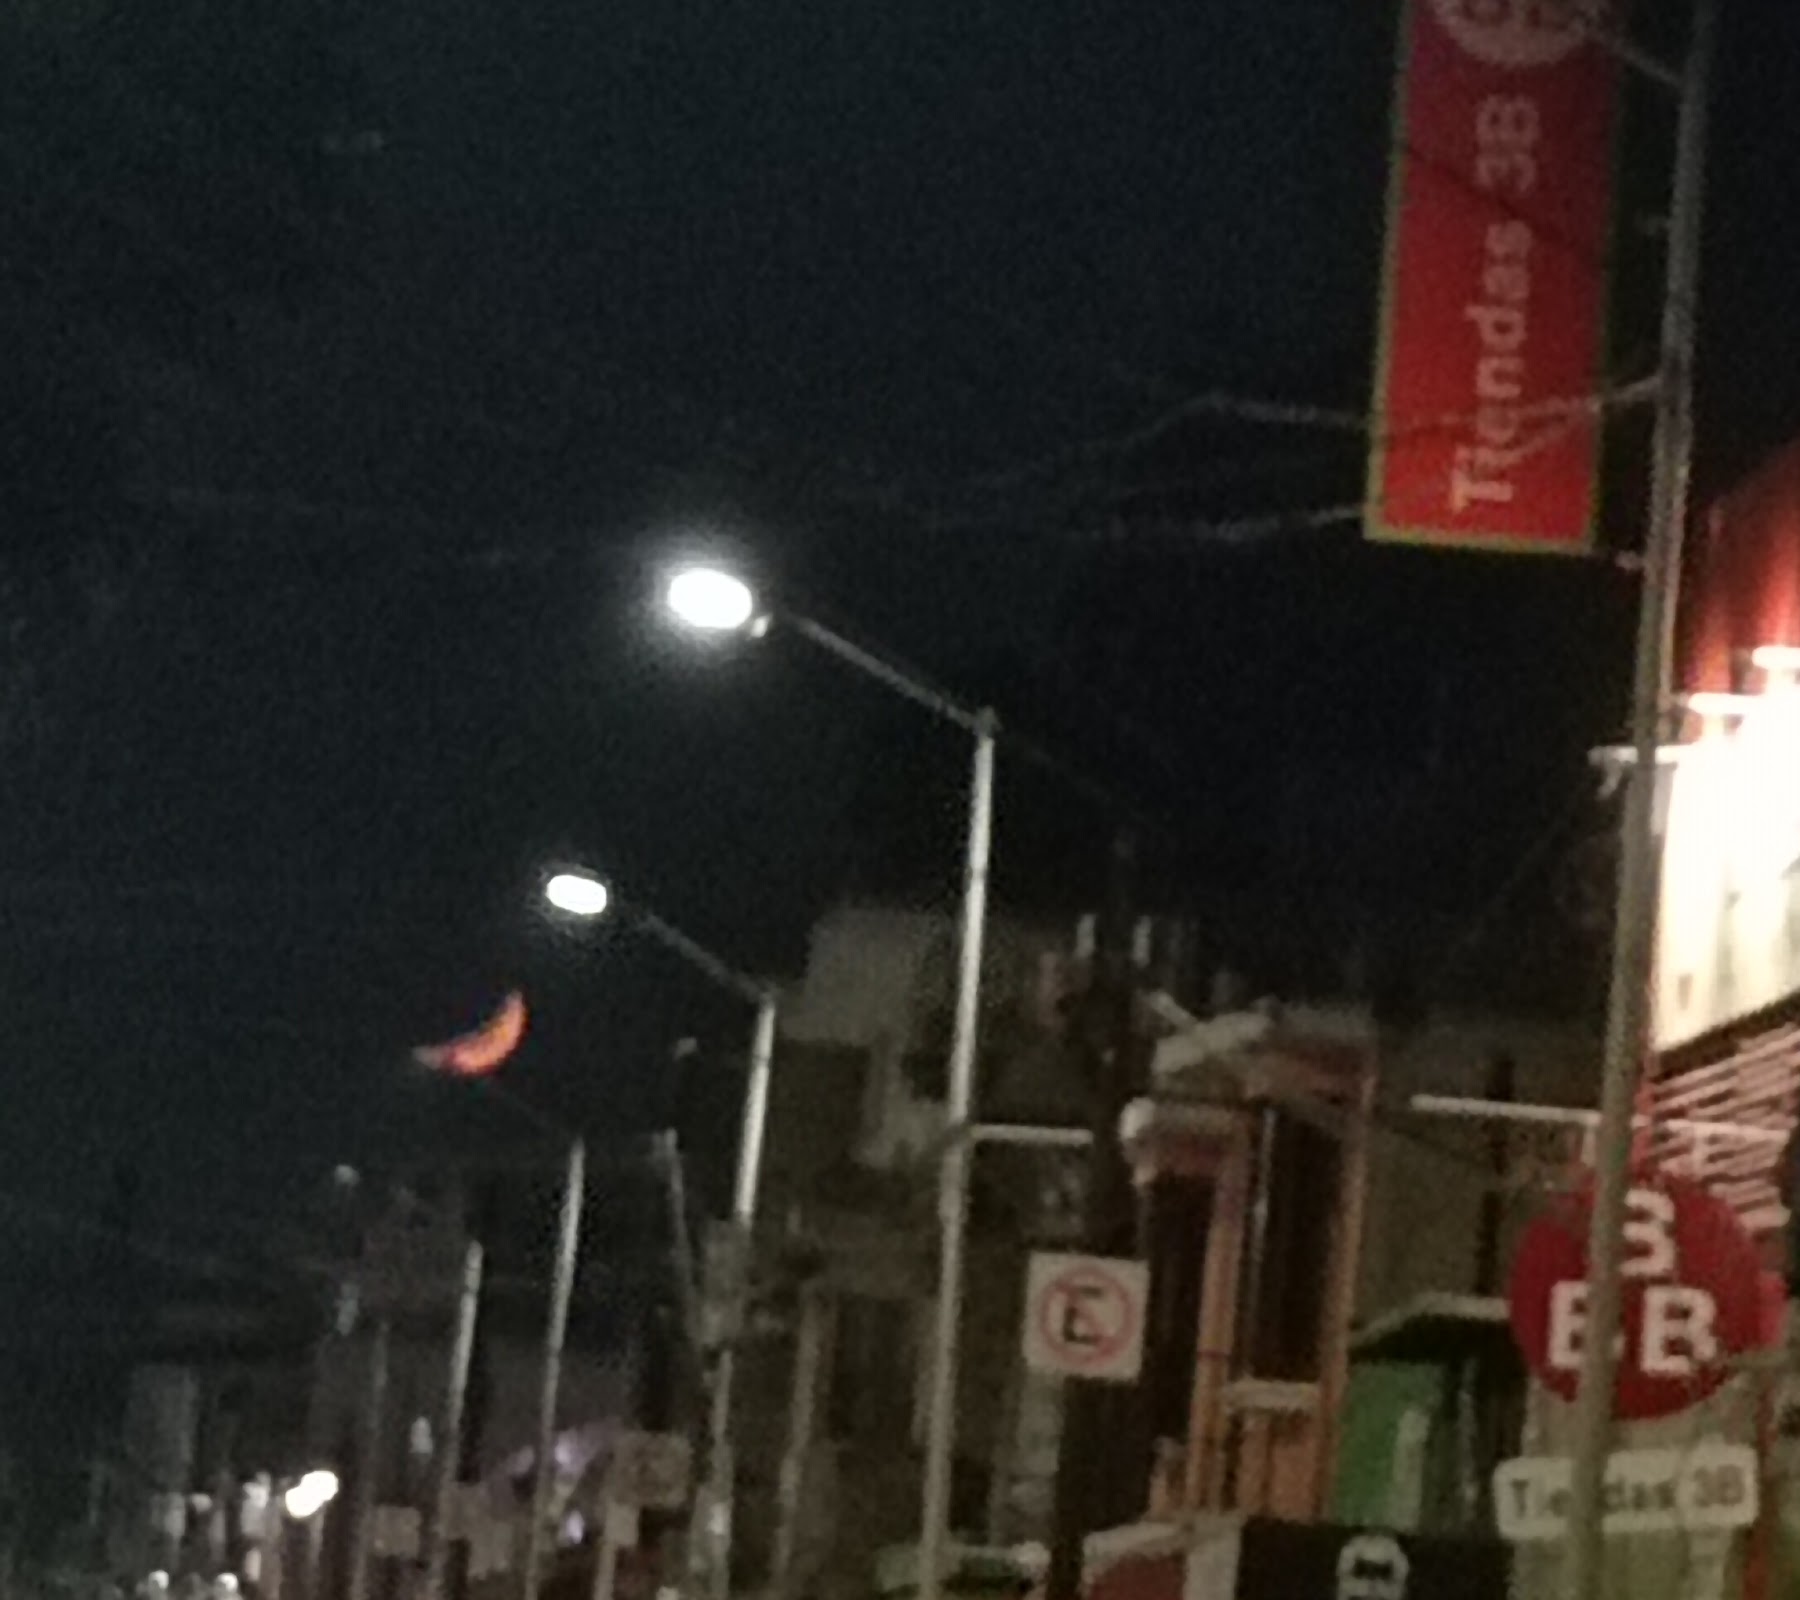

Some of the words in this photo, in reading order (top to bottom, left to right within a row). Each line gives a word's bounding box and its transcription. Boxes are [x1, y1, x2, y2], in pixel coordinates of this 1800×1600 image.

[1473, 93, 1541, 194] 3B
[1449, 220, 1534, 513] Tiendas
[1617, 1188, 1676, 1279] 3
